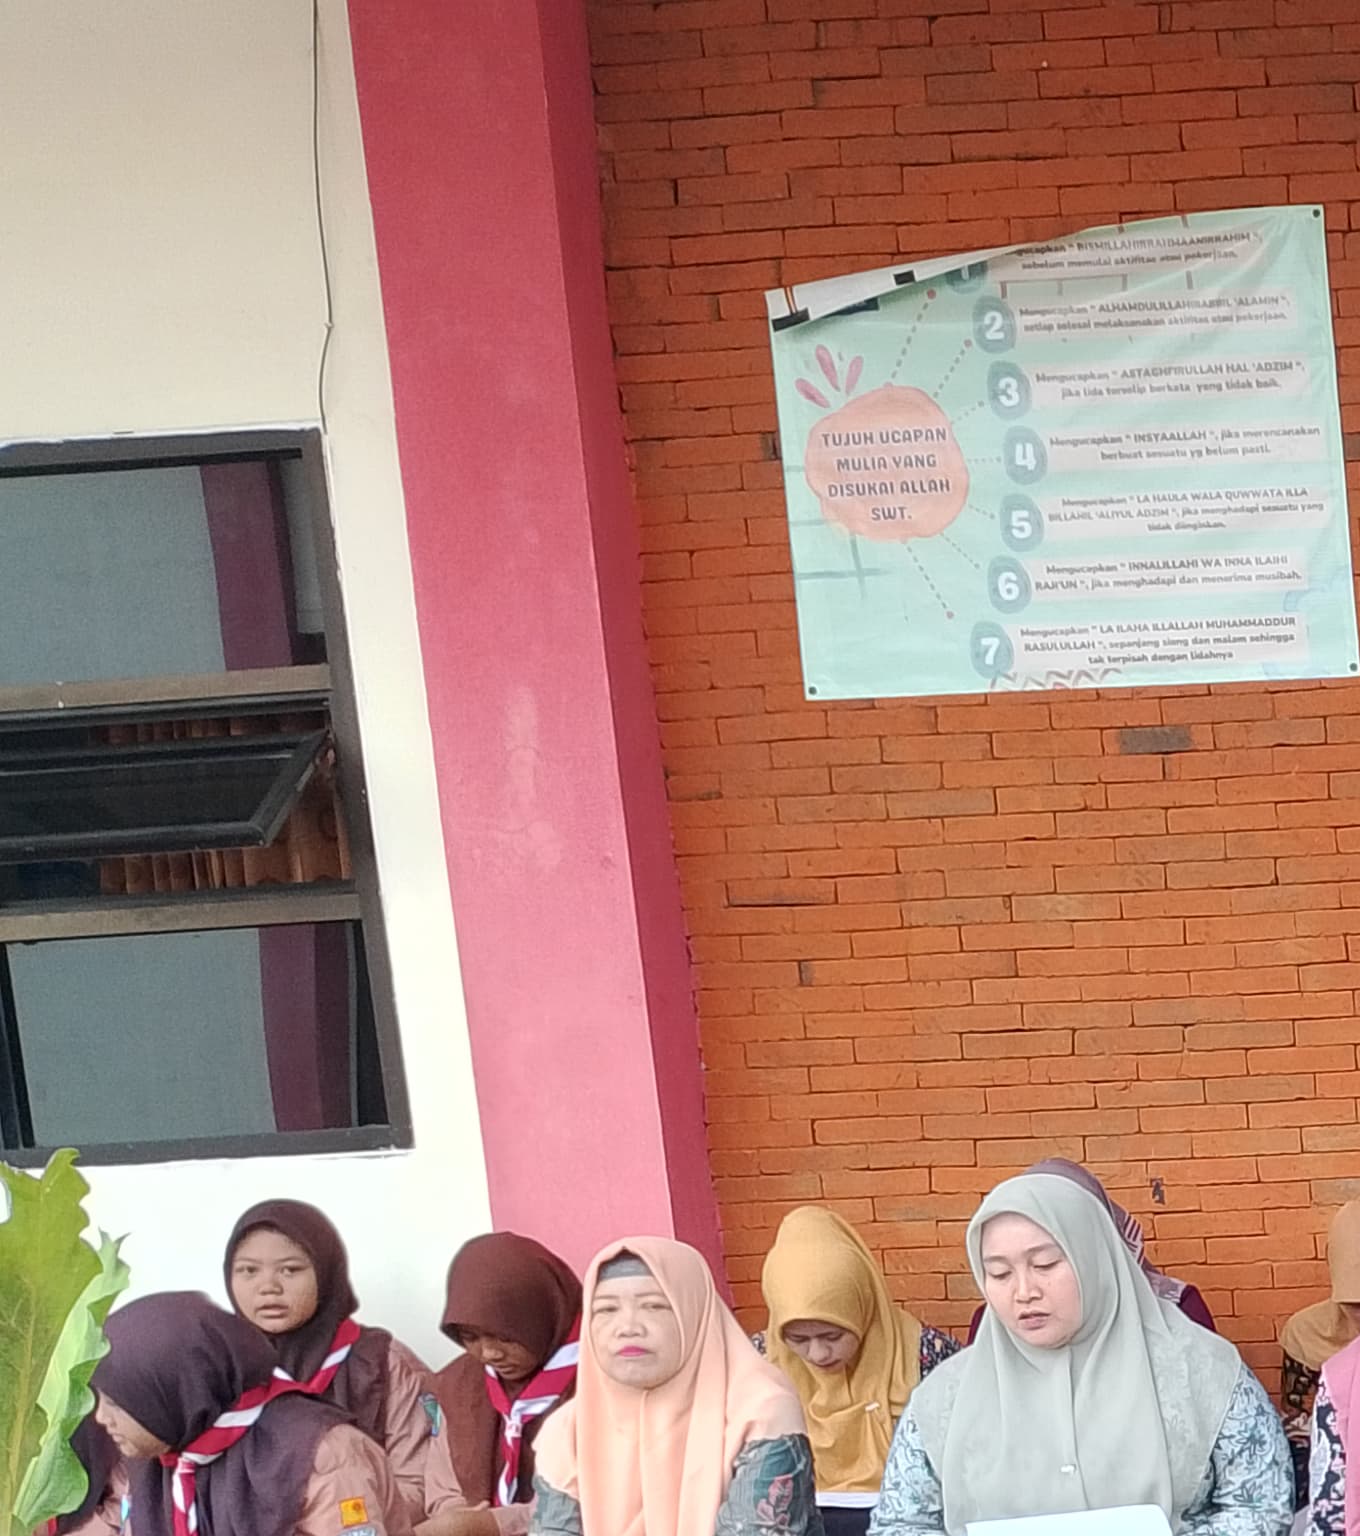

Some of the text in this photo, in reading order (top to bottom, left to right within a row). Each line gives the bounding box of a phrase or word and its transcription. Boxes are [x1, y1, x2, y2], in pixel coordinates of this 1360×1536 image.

[984, 311, 1005, 341] 2
[999, 376, 1019, 407] 3
[821, 427, 947, 448] TUJUH UCAPAN
[836, 454, 937, 473] MULIA YANG
[1014, 441, 1036, 471] 4
[828, 478, 951, 498] DISUKAI ALLAH
[871, 506, 912, 521] SWT.
[1010, 510, 1032, 540] 5
[1201, 557, 1222, 568] WA
[997, 571, 1020, 601] 6
[1099, 624, 1114, 634] LA
[979, 636, 1001, 666] 7
